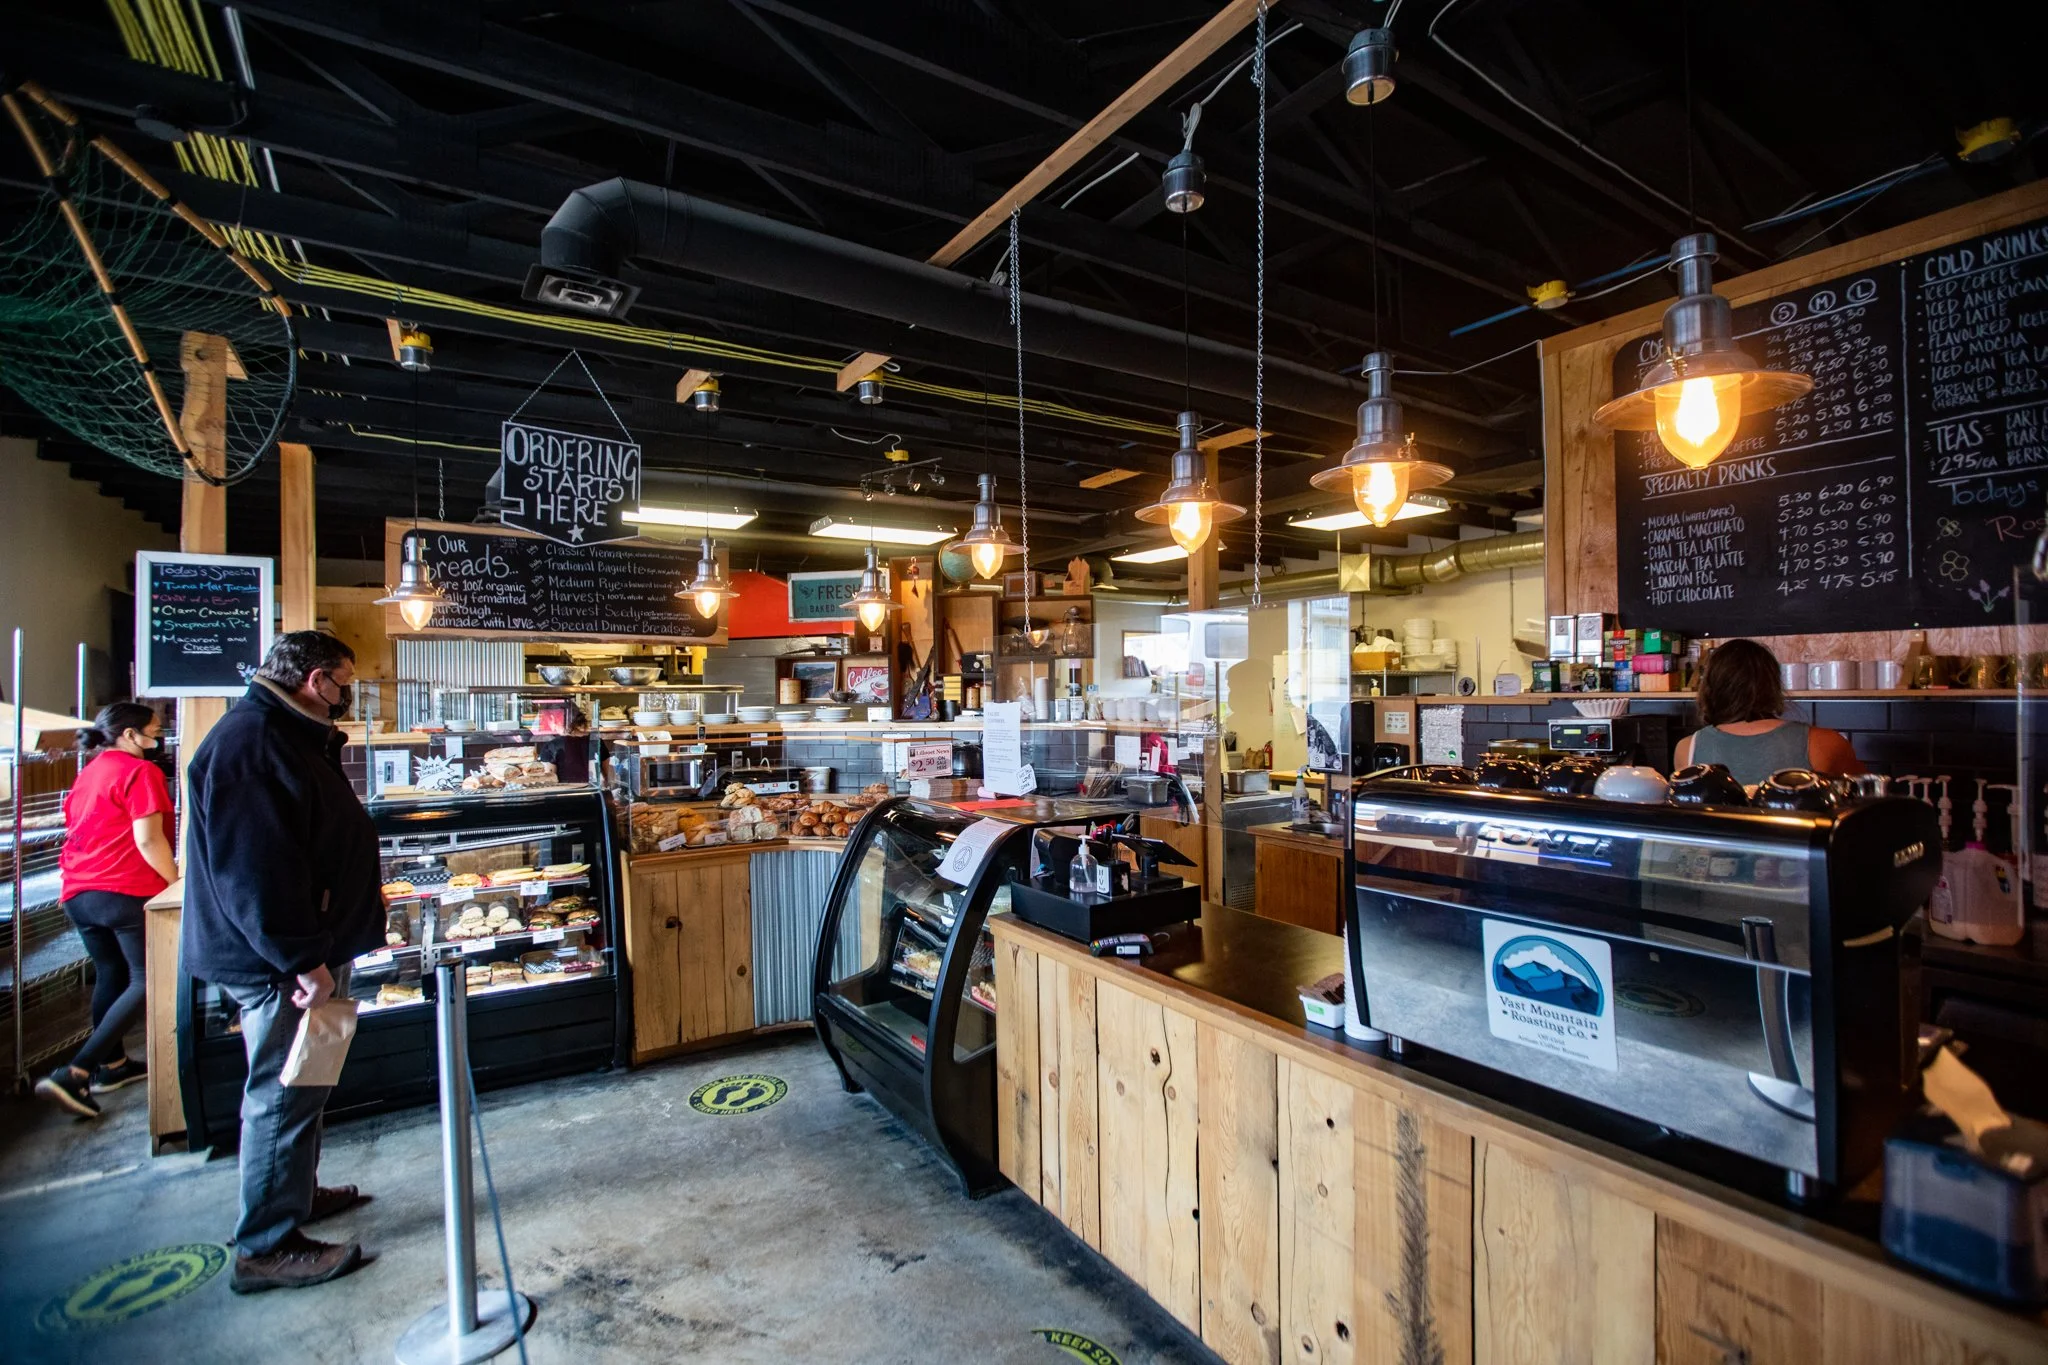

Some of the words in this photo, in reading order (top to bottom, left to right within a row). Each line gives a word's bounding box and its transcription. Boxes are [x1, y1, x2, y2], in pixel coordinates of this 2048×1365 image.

[1924, 249, 1974, 282] COLD
[1925, 280, 1957, 300] ICED
[1961, 263, 2020, 292] COFFEE
[1830, 307, 1865, 327] 3.30
[1926, 299, 1959, 317] ICED
[1928, 313, 1960, 334] ICED
[1966, 302, 2007, 325] LATTE
[1840, 336, 1871, 353] 3.90
[1929, 318, 2011, 350] FLAVOURED
[1812, 356, 1846, 375] 4.50
[1850, 345, 1888, 366] 5.50
[1930, 346, 1963, 364] ICED
[1969, 332, 2028, 355] MOCHA
[1853, 357, 1889, 379] 6.30
[1932, 364, 1961, 383] ICED
[1964, 357, 1996, 374] CHAI
[2001, 351, 2030, 367] TEA
[1854, 373, 1894, 396] 6.30
[1933, 375, 1995, 398] BREWED
[2005, 368, 2037, 386] ICED
[1775, 413, 1811, 432] 5.20
[1815, 402, 1851, 421] 5.85
[1857, 393, 1893, 412] 6.50
[2006, 408, 2038, 429] EARL
[1778, 428, 1809, 445] 2.30
[1819, 419, 1852, 437] 2.50
[1860, 411, 1894, 429] 2.75
[1928, 420, 1983, 453] TEAS
[2005, 426, 2039, 446] PEAR
[506, 427, 638, 501] ORDERING
[1645, 469, 1713, 497] SPECIALTY
[1719, 457, 1777, 485] DRINKS
[524, 467, 625, 502] STARTS
[1938, 477, 2039, 508] Todays
[536, 493, 608, 527] HERE
[1648, 514, 1680, 530] MOCHA
[1779, 492, 1812, 507] 5.30
[1818, 484, 1854, 500] 6.20
[1858, 475, 1894, 493] 6.90
[1648, 528, 1686, 544] CARAMEL
[1688, 517, 1745, 534] MACCHIATO
[1778, 506, 1813, 523] 5.30
[1819, 500, 1854, 516] 6.20
[1860, 494, 1896, 510] 6.90
[546, 543, 585, 557] Classic
[1649, 544, 1672, 561] CHAI
[1677, 539, 1697, 557] TEA
[1700, 534, 1732, 553] LATTE
[1779, 524, 1808, 541] 4.70
[1812, 519, 1849, 536] 5.30
[1856, 513, 1892, 530] 5.90
[1650, 562, 1689, 578] MATCHA
[1692, 555, 1711, 573] TEA
[1714, 551, 1746, 568] LATTE
[1778, 543, 1809, 558] 4.70
[1813, 538, 1848, 554] 5.30
[1857, 532, 1895, 547] 5.90
[153, 563, 207, 578] Today's
[208, 566, 257, 581] Special
[548, 575, 594, 588] Medium
[1651, 572, 1693, 590] LONDON
[1778, 558, 1810, 576] 4.70
[1814, 555, 1849, 570] 5.30
[1860, 551, 1895, 567] 5.90
[162, 581, 197, 592] Tuna
[440, 582, 459, 591] are
[463, 579, 484, 591] 100%
[486, 582, 526, 596] organic
[471, 592, 528, 605] fermented
[1652, 588, 1674, 606] HOT
[1676, 584, 1735, 603] CHOCOLATE
[1777, 579, 1809, 596] 4.25
[1861, 569, 1899, 588] 5.45
[161, 605, 197, 616] Clam
[432, 604, 503, 619] ourdough...
[550, 603, 601, 616] Harvest
[809, 604, 835, 613] BAKED
[226, 617, 251, 629] Pie
[427, 616, 482, 628] ndmade
[484, 616, 505, 628] with
[551, 616, 598, 632] Special
[601, 619, 638, 632] Dinner
[162, 634, 219, 644] Macaroni
[183, 643, 223, 651] Cheese
[848, 667, 882, 690] Coffee
[1499, 995, 1525, 1012] Vast
[1531, 1004, 1598, 1031] Mountain
[1511, 1009, 1564, 1035] Roasting
[1567, 1025, 1588, 1040] Co.
[1051, 1331, 1092, 1350] KEEP
